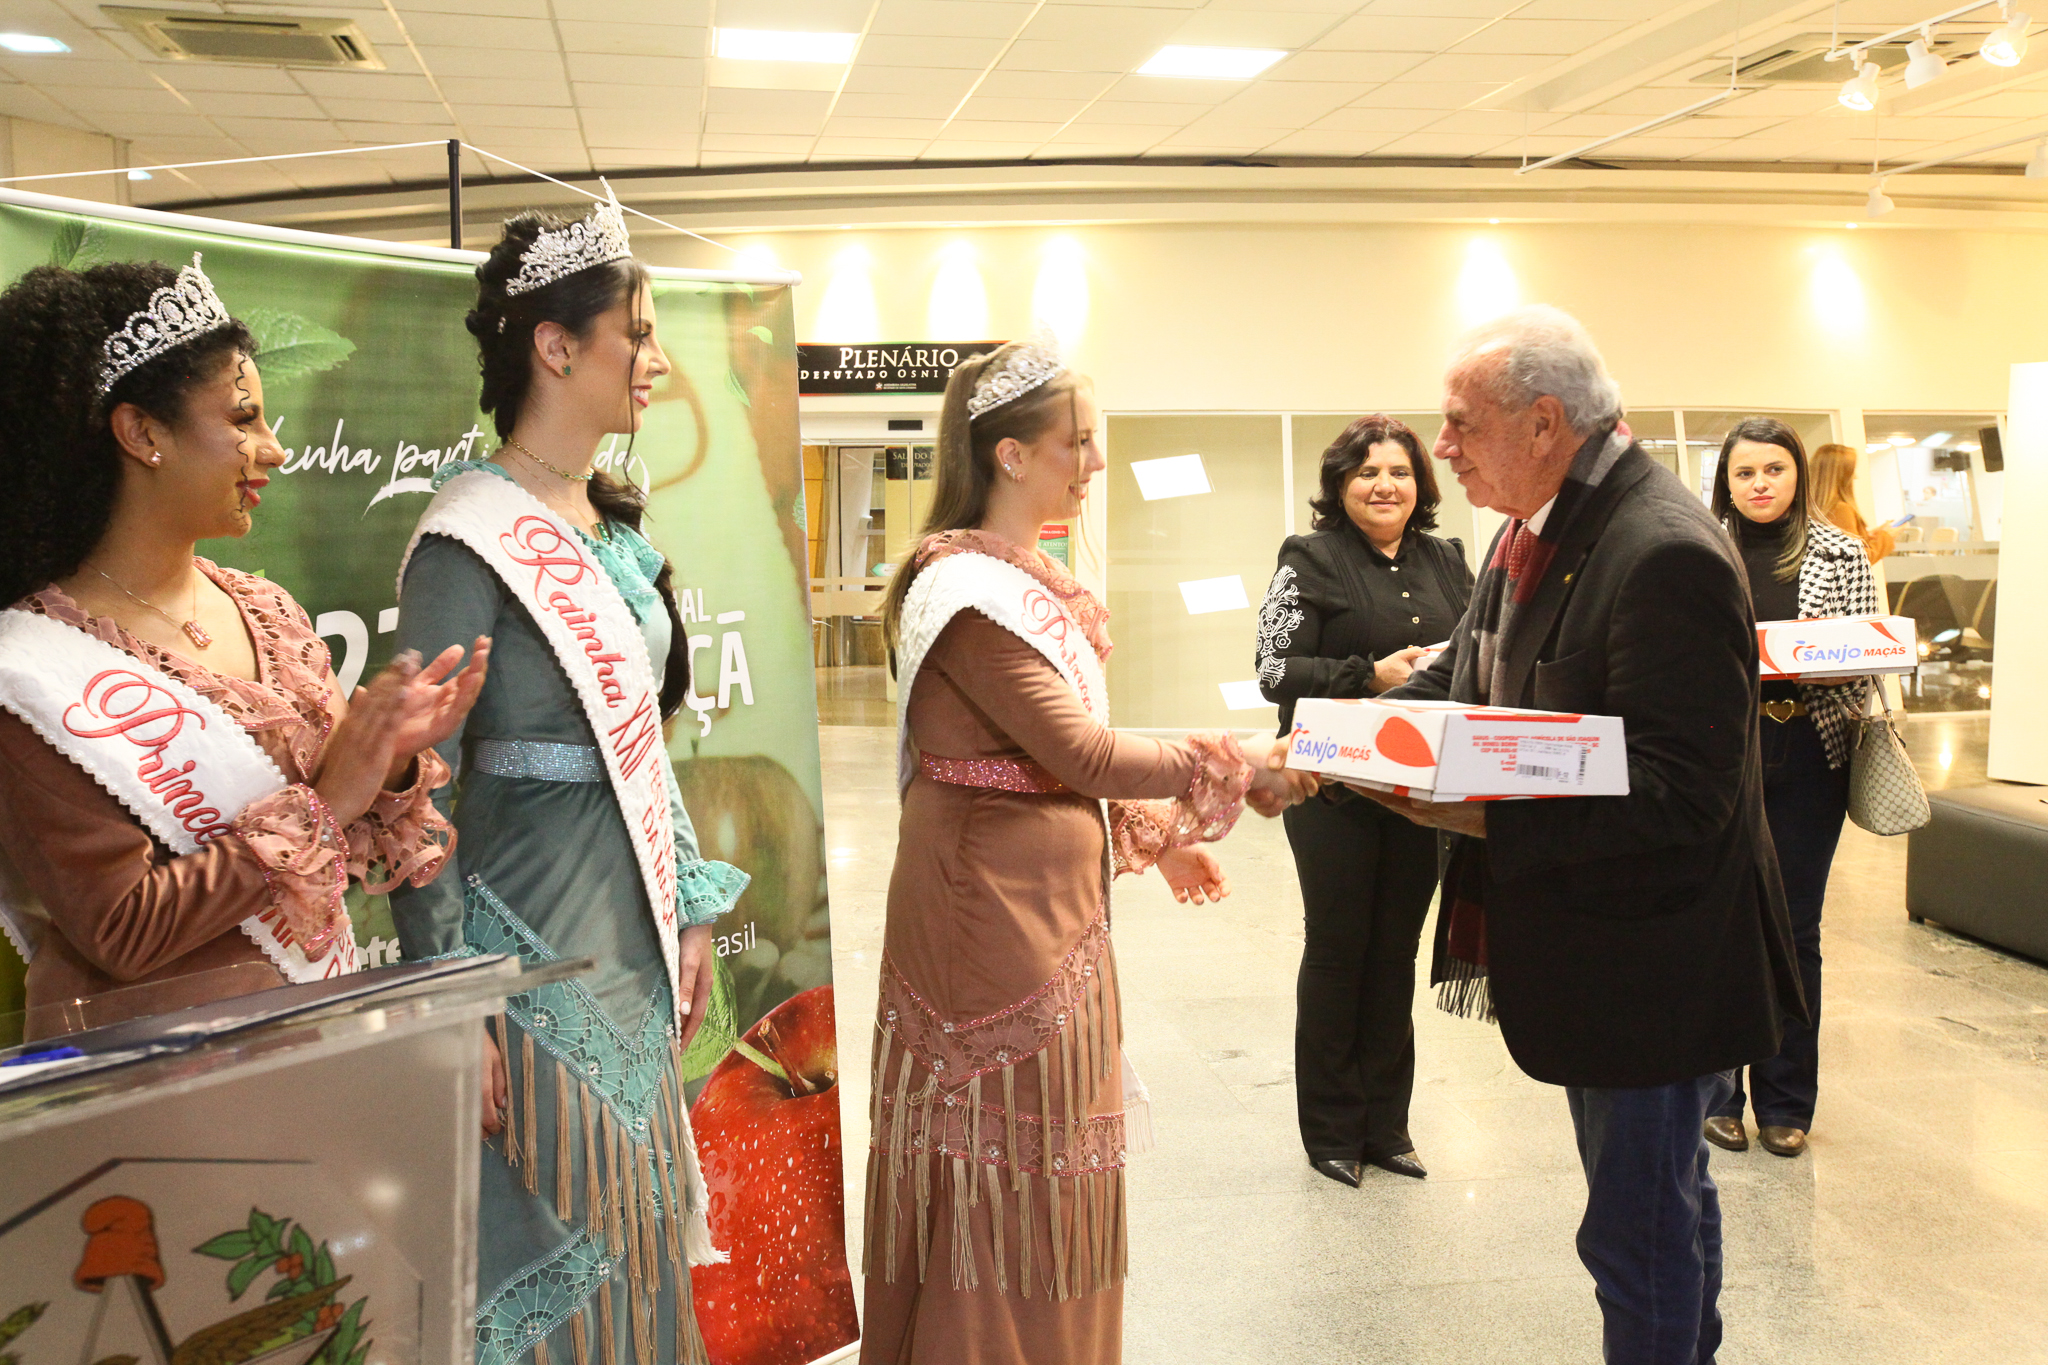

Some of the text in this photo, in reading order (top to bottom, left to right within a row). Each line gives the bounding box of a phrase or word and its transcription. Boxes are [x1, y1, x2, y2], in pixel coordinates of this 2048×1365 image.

[800, 368, 956, 380] DEPUTADO OSNI R
[839, 346, 958, 369] PLENÁRIO
[893, 452, 908, 460] SAL
[673, 587, 711, 623] AL
[499, 515, 657, 782] Rainha XXII
[673, 610, 754, 737] ÇÃ
[63, 669, 233, 845] Prince
[711, 921, 756, 957] asil
